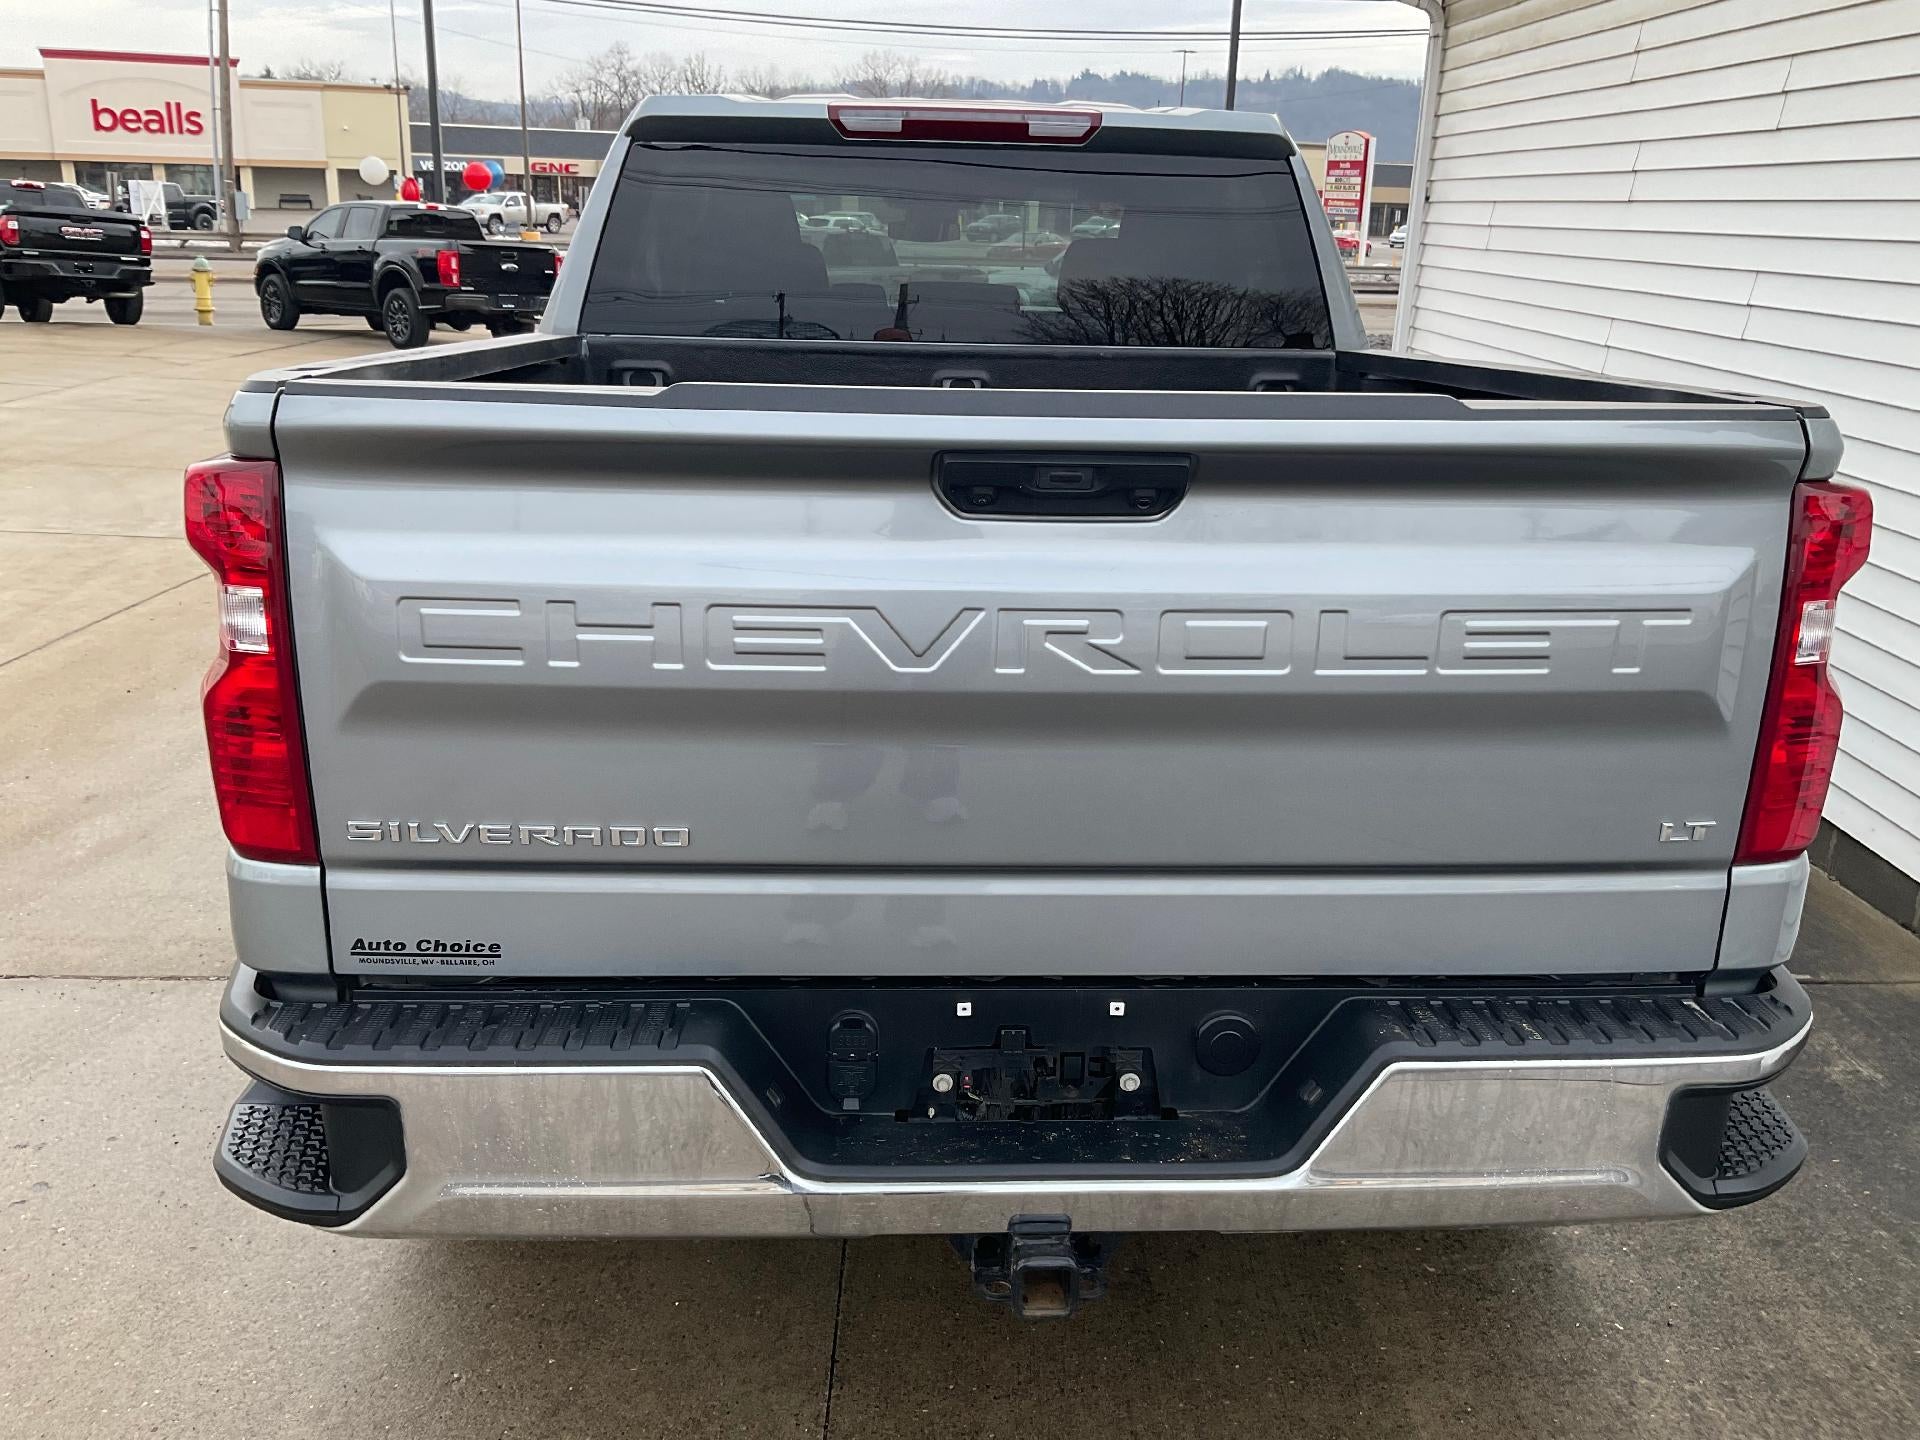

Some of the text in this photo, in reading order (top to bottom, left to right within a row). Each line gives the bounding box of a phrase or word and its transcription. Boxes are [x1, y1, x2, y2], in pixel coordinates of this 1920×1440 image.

[90, 98, 204, 135] bealls
[420, 160, 468, 171] vezon
[531, 162, 579, 174] GNC
[397, 596, 1692, 676] CHEVROLET
[347, 820, 690, 847] SILVERADO
[1659, 821, 1717, 841] LT
[351, 938, 502, 953] Auto Choice
[358, 958, 420, 966] MOUNDSVILLE,
